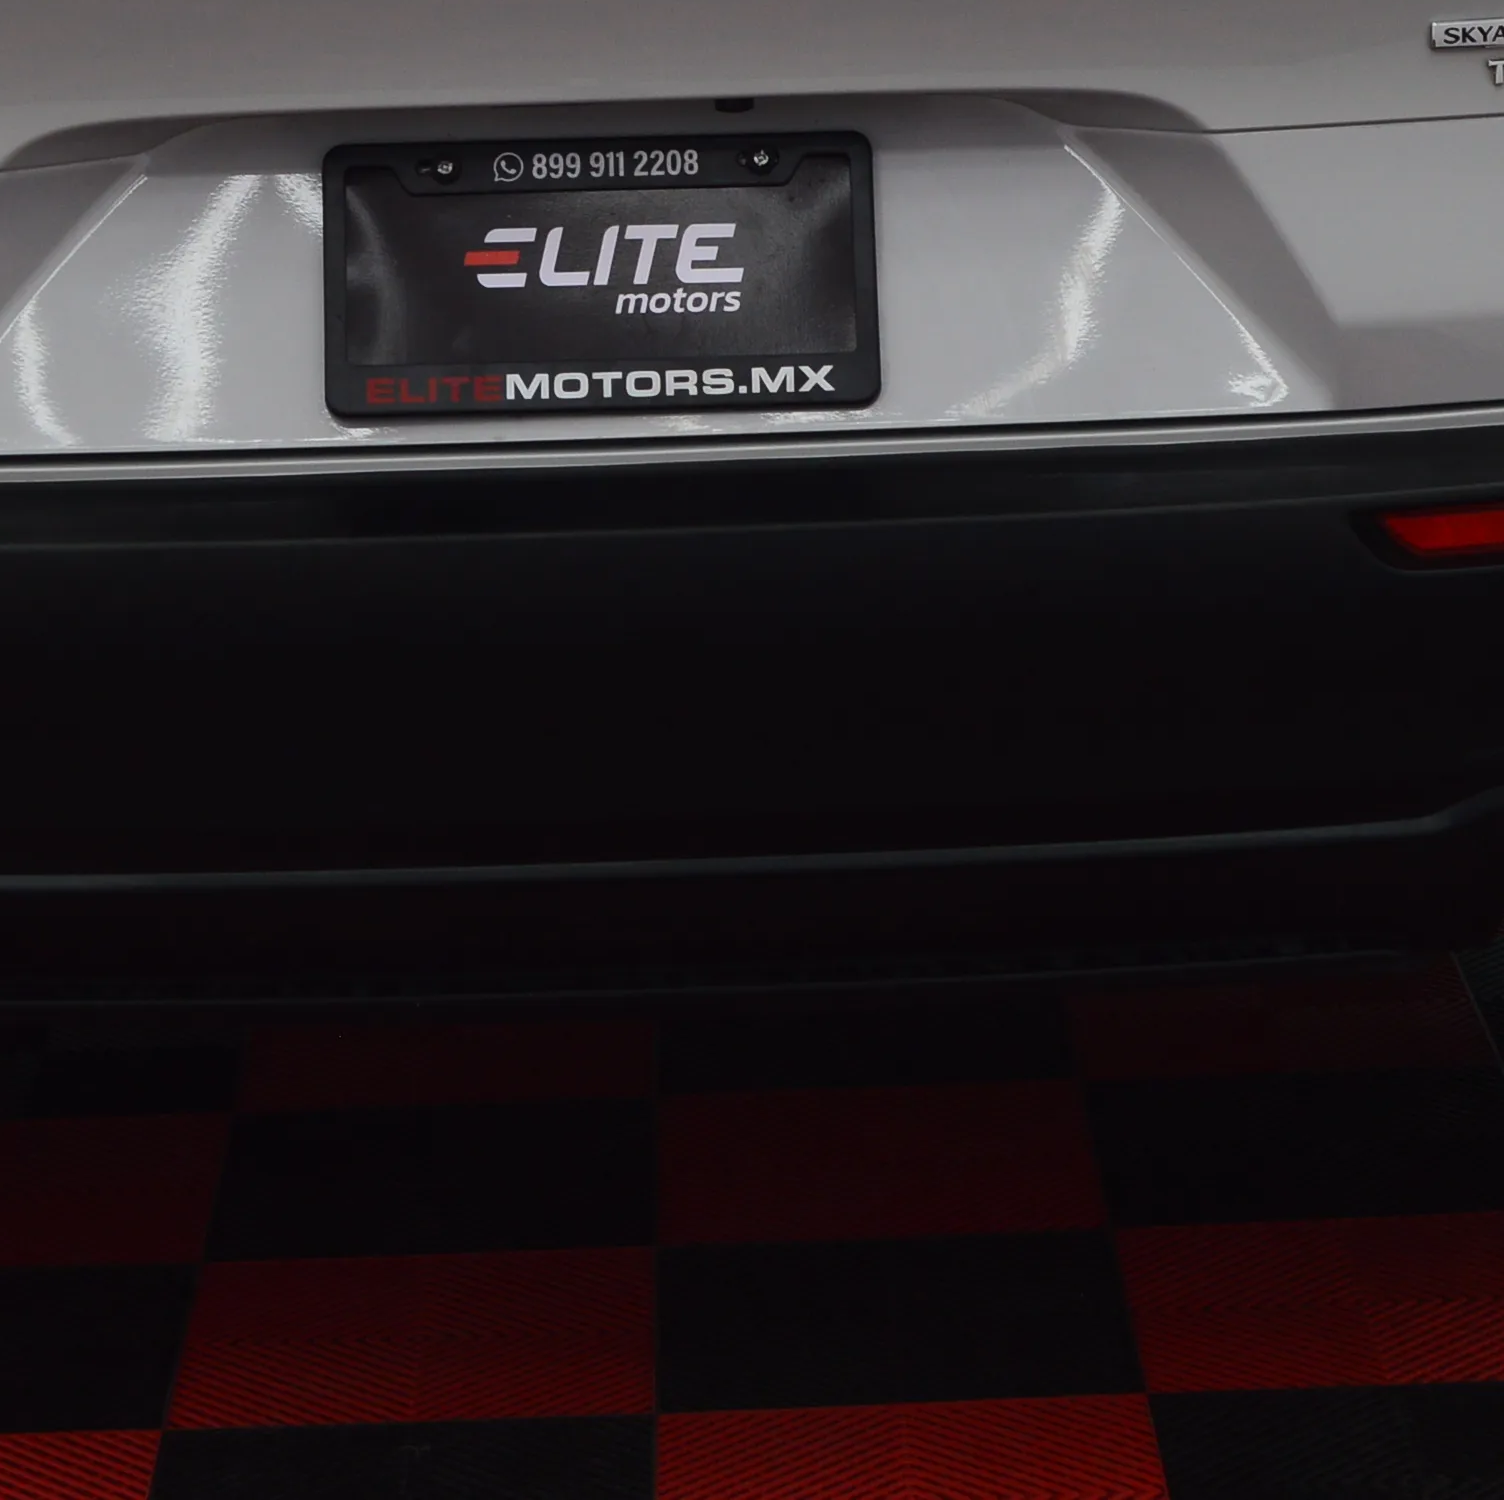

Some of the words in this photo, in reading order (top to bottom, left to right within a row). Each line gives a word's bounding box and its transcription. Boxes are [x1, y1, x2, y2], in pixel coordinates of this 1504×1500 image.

[531, 152, 582, 180] 899
[589, 151, 626, 179] 911
[632, 149, 700, 178] 2208
[463, 222, 745, 289] ELITE
[615, 286, 742, 315] motors
[365, 364, 836, 405] ELITEMOTORS.MX
